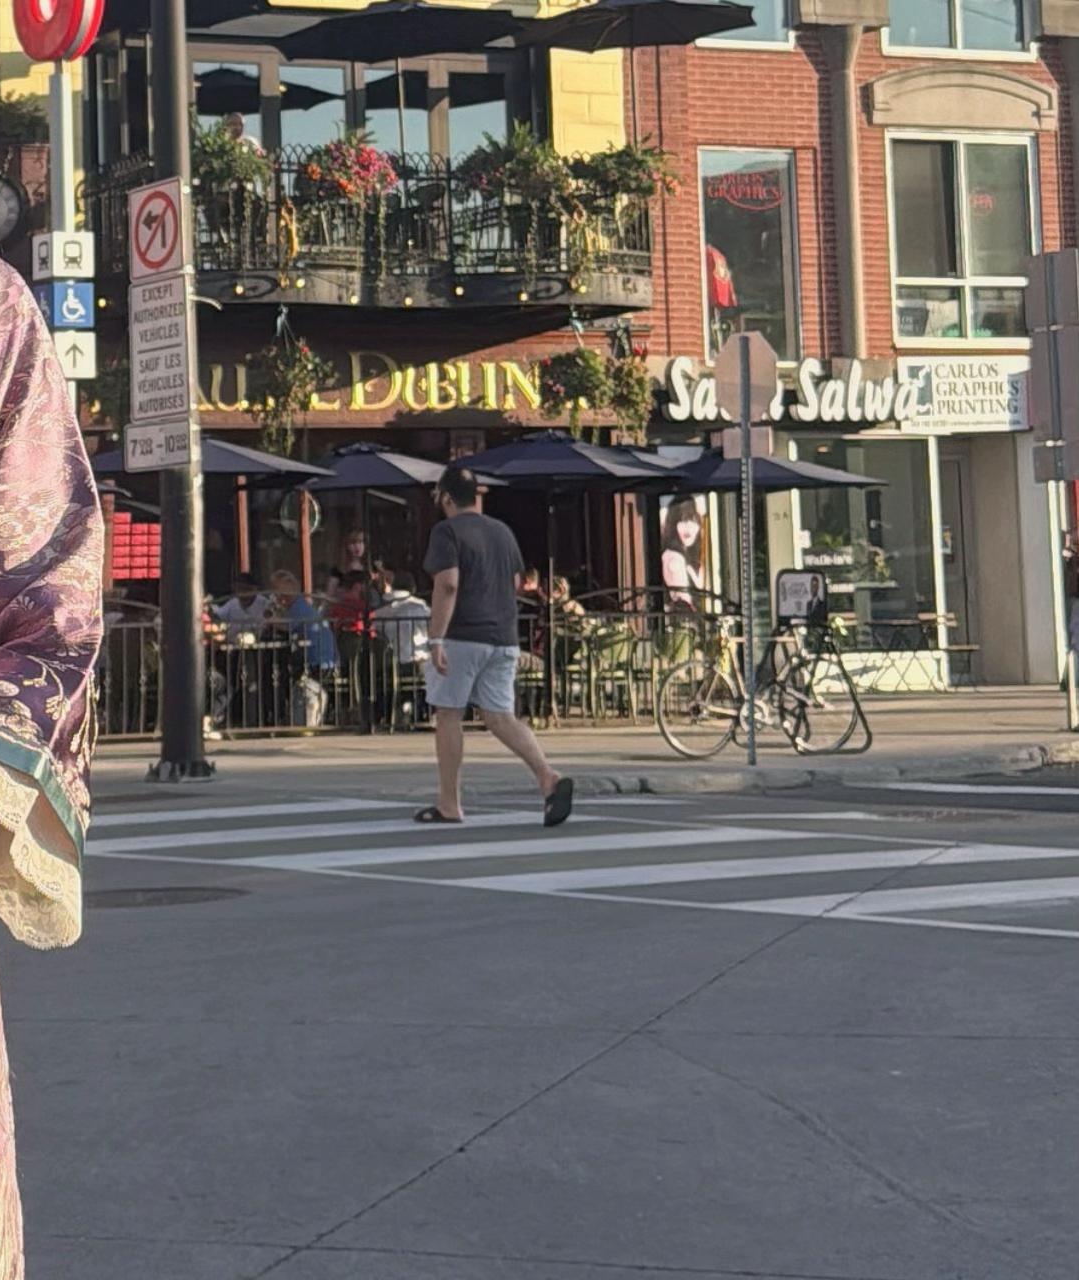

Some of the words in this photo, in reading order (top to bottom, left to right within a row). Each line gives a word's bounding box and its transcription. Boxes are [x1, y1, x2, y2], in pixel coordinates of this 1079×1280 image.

[142, 283, 172, 302] EXCEPT
[134, 302, 185, 323] AUTHORIZED
[139, 322, 179, 343] VEHICLES
[139, 357, 160, 374] SAUF
[164, 353, 181, 370] LES
[934, 363, 998, 379] CARLOS
[349, 351, 589, 412] DUBLIN
[798, 357, 919, 422] Salwa
[936, 380, 1019, 397] GRAPHICS
[937, 399, 1018, 415] PRINTING
